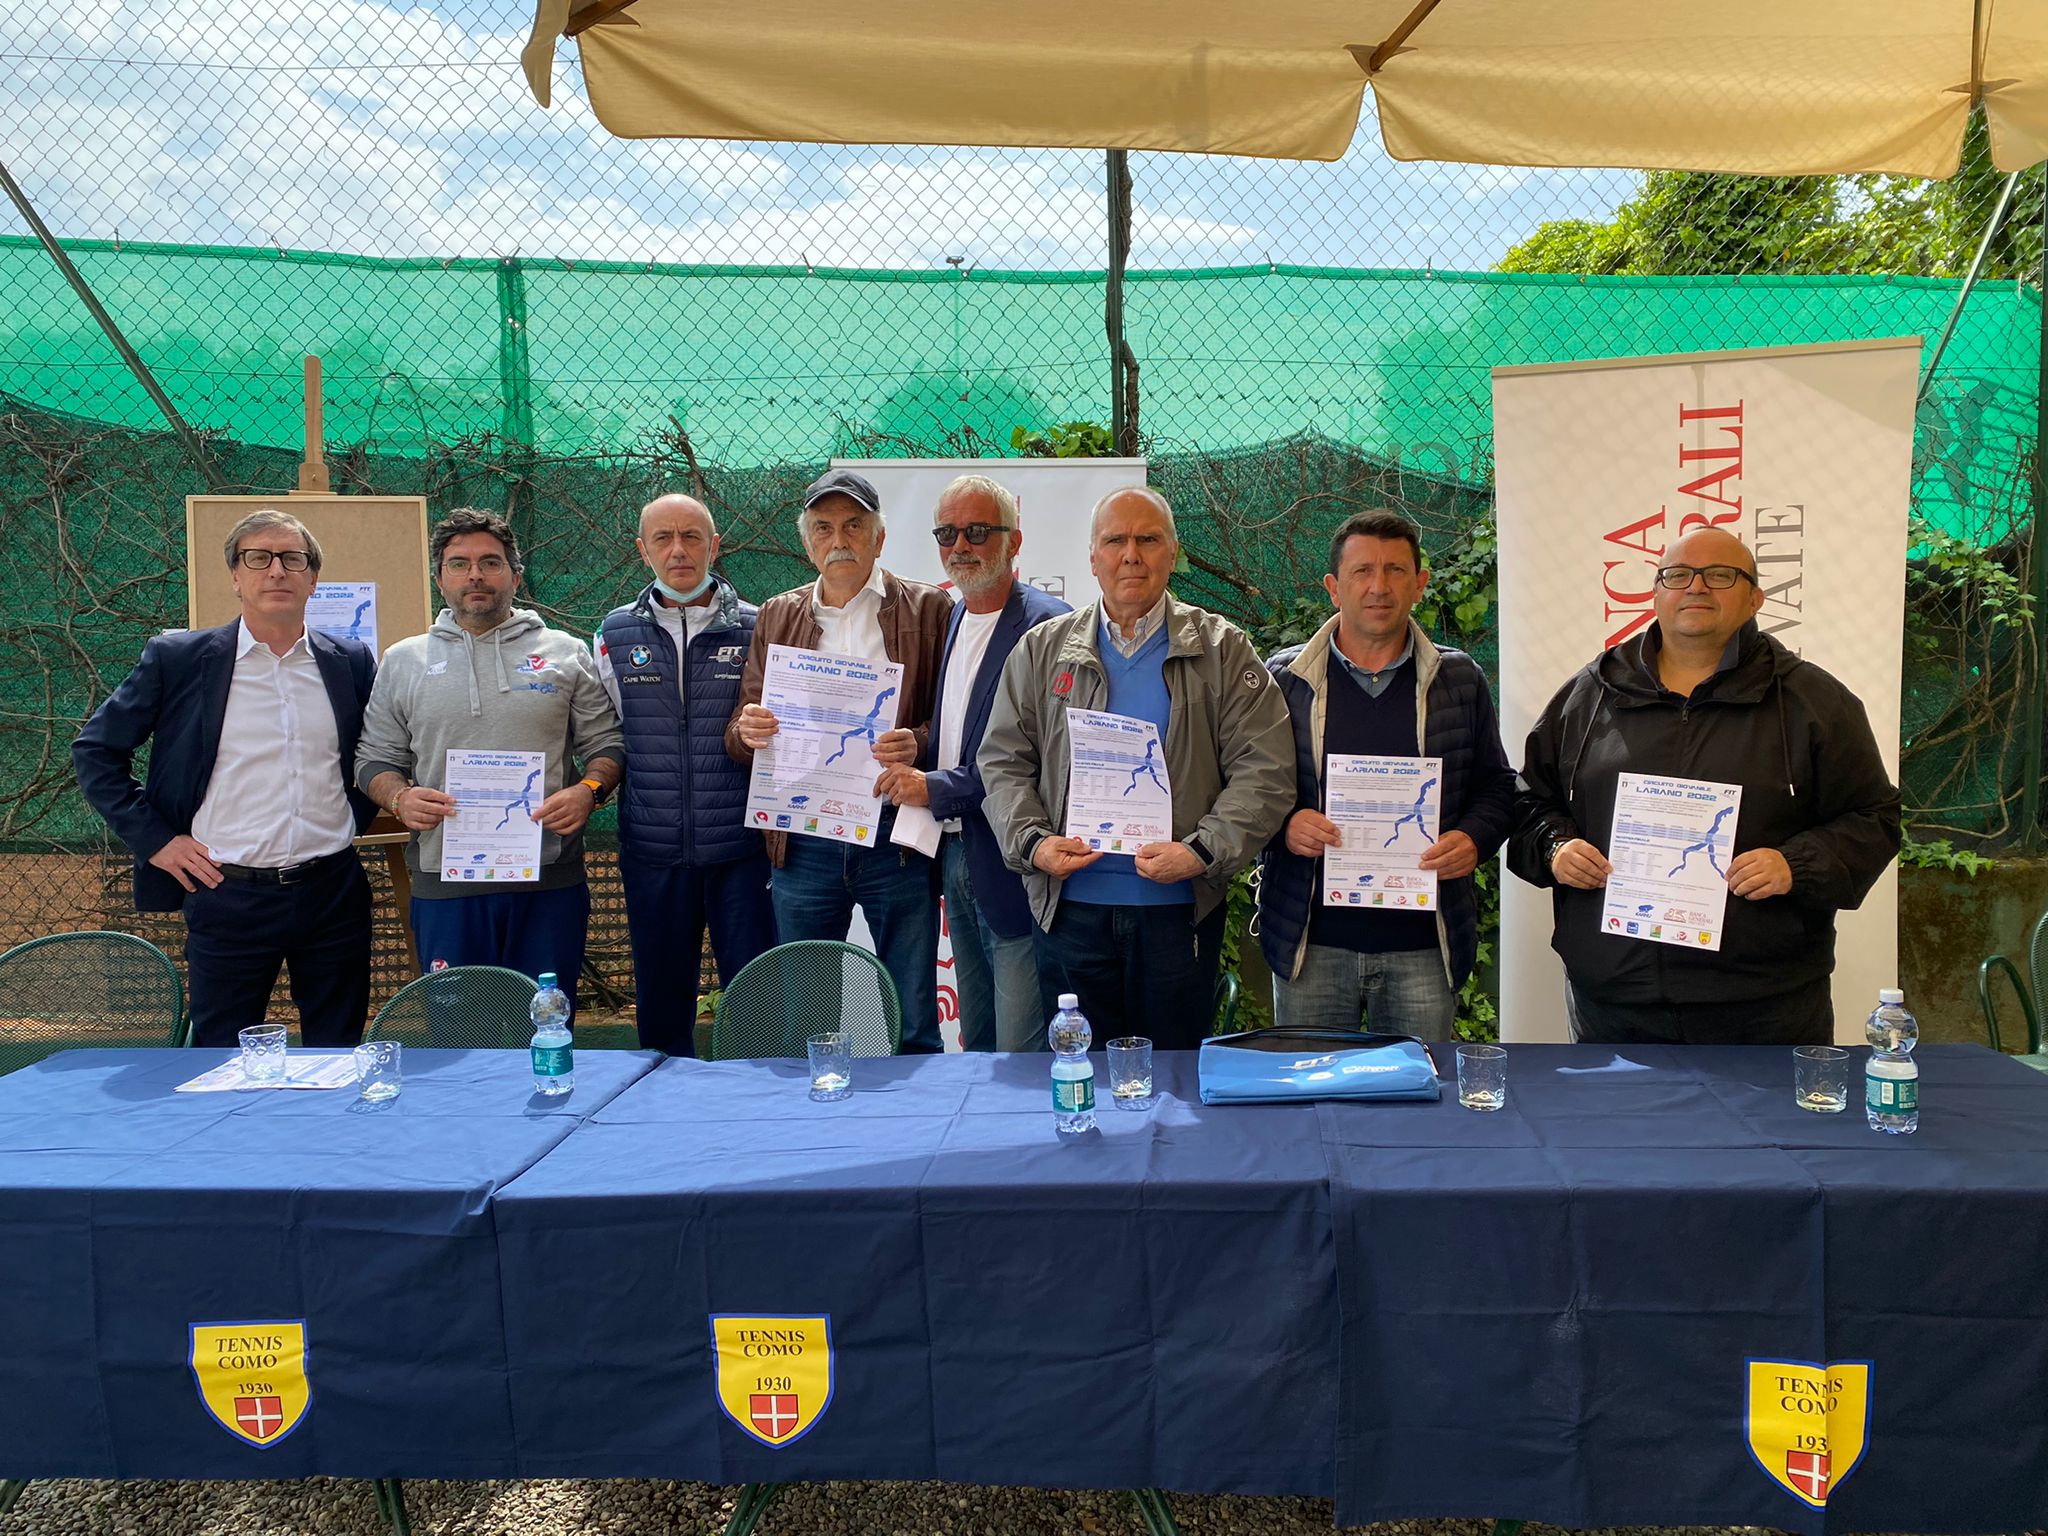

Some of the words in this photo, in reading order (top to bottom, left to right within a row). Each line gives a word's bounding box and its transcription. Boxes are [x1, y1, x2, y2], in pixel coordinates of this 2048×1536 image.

[1677, 399, 1744, 541] RALI
[1603, 505, 1666, 650] NCA
[1755, 504, 1804, 634] VATE
[797, 654, 833, 665] CIRCUITO
[835, 659, 873, 671] GIOVANILE
[788, 661, 842, 676] LARIANO
[846, 669, 879, 682] 2022
[1082, 720, 1119, 729] LARIANO
[1345, 766, 1389, 774] LARIANO
[1636, 786, 1683, 798] LARIANO
[1686, 792, 1718, 802] 2022
[215, 1335, 283, 1353] TENNIS
[736, 1330, 806, 1342] TENNIS
[743, 1343, 803, 1358] COMO
[218, 1353, 278, 1370] COMO
[238, 1382, 274, 1395] 1930
[756, 1376, 792, 1391] 1930
[1796, 1434, 1828, 1452] 193
